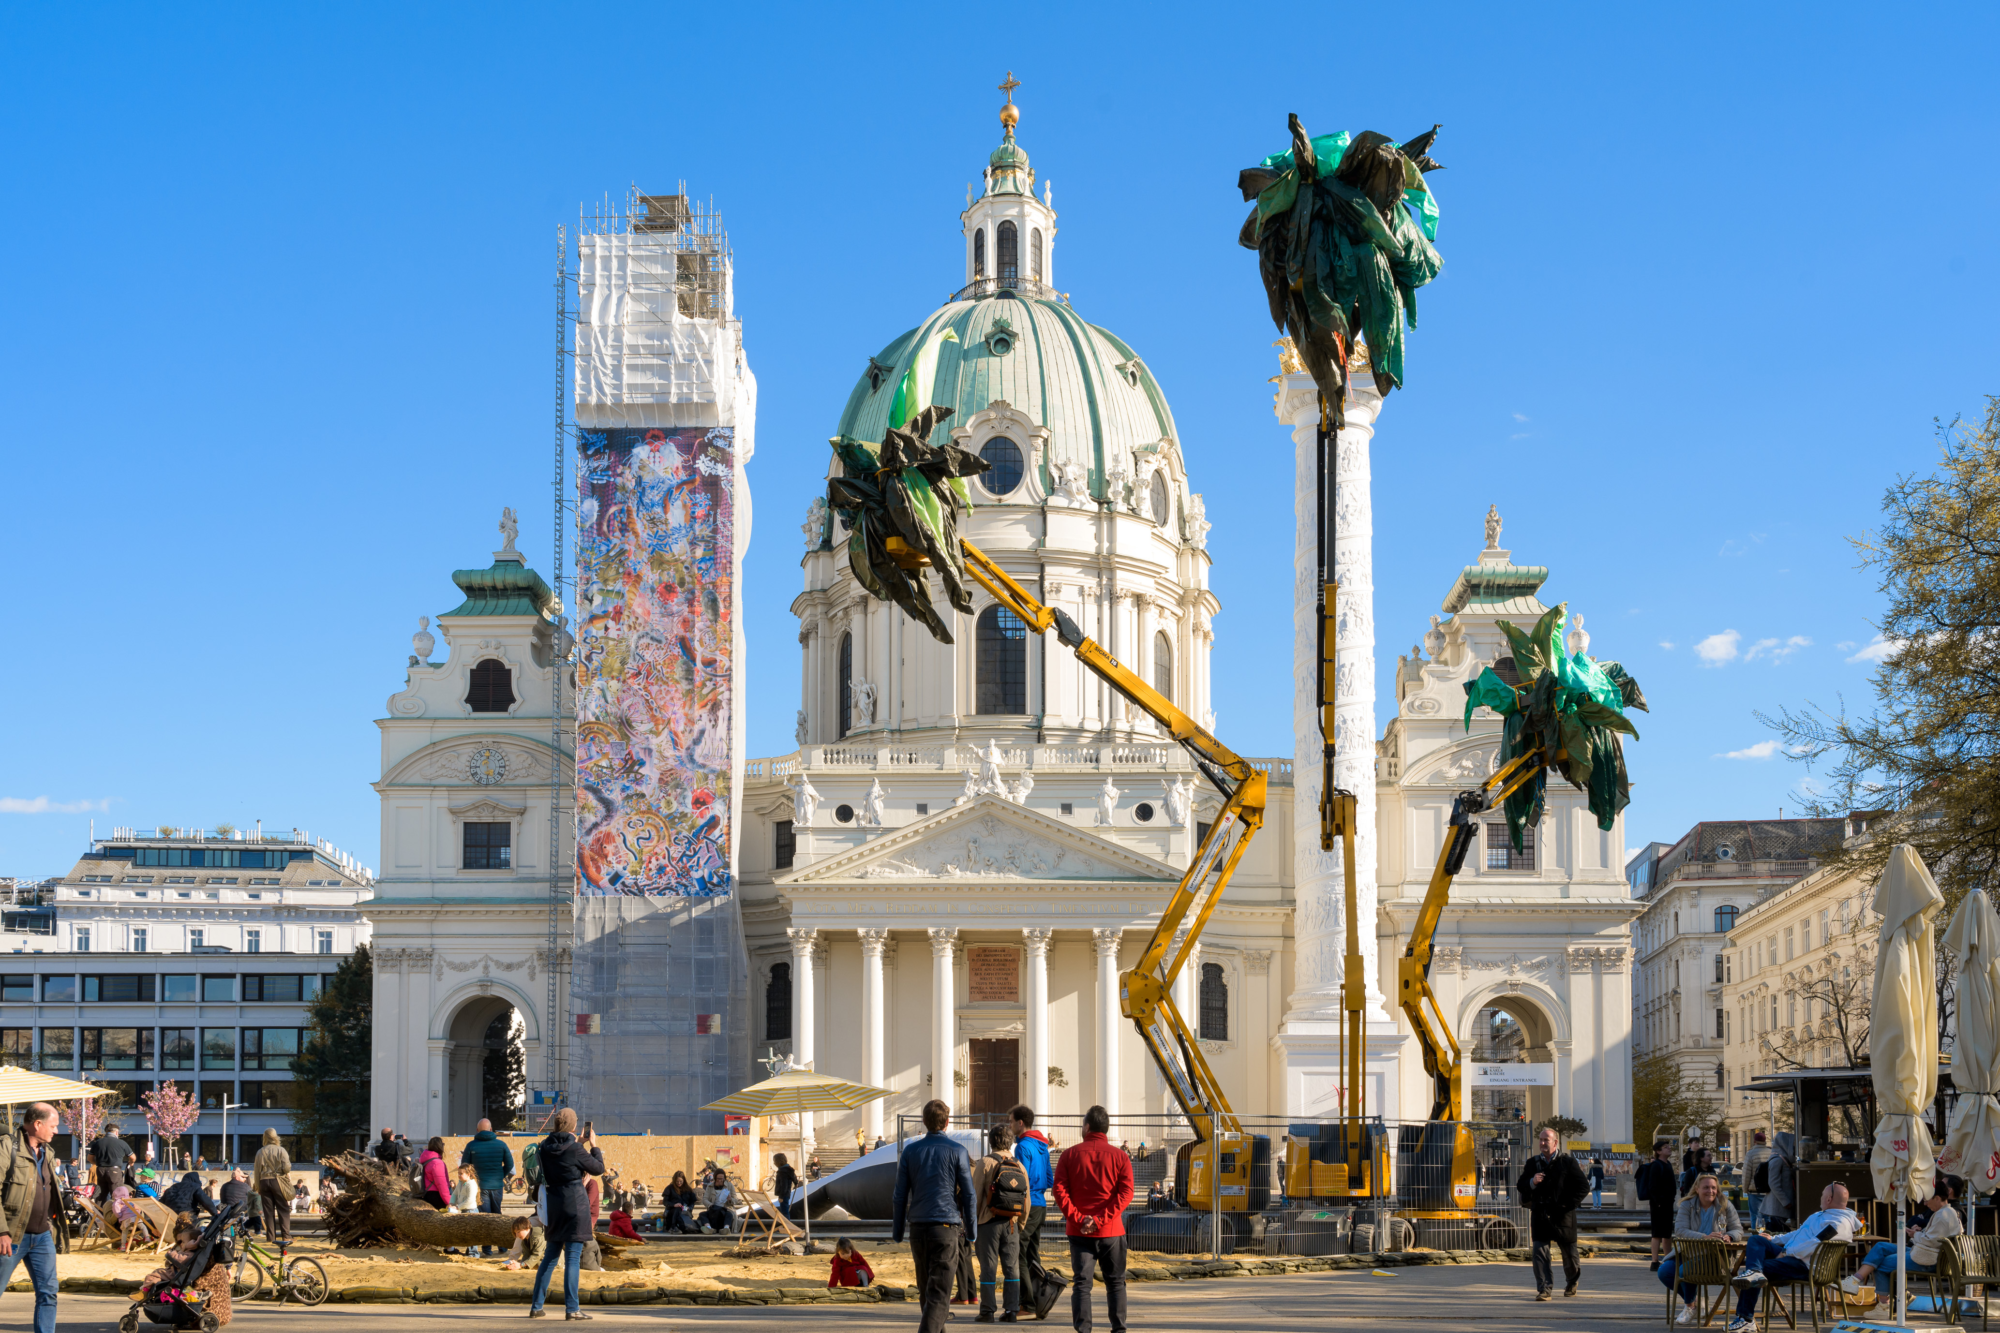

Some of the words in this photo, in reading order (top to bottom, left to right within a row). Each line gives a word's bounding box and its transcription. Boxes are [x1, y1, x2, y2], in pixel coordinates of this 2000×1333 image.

[1094, 646, 1110, 661] SIGMA
[1194, 725, 1213, 743] Haulotte
[805, 902, 838, 914] VOTA
[848, 902, 876, 914] MEA
[886, 902, 937, 914] REDDAM
[947, 902, 959, 914] IN
[1572, 1151, 1599, 1159] VIVALDI
[1604, 1152, 1631, 1160] VIVALDI
